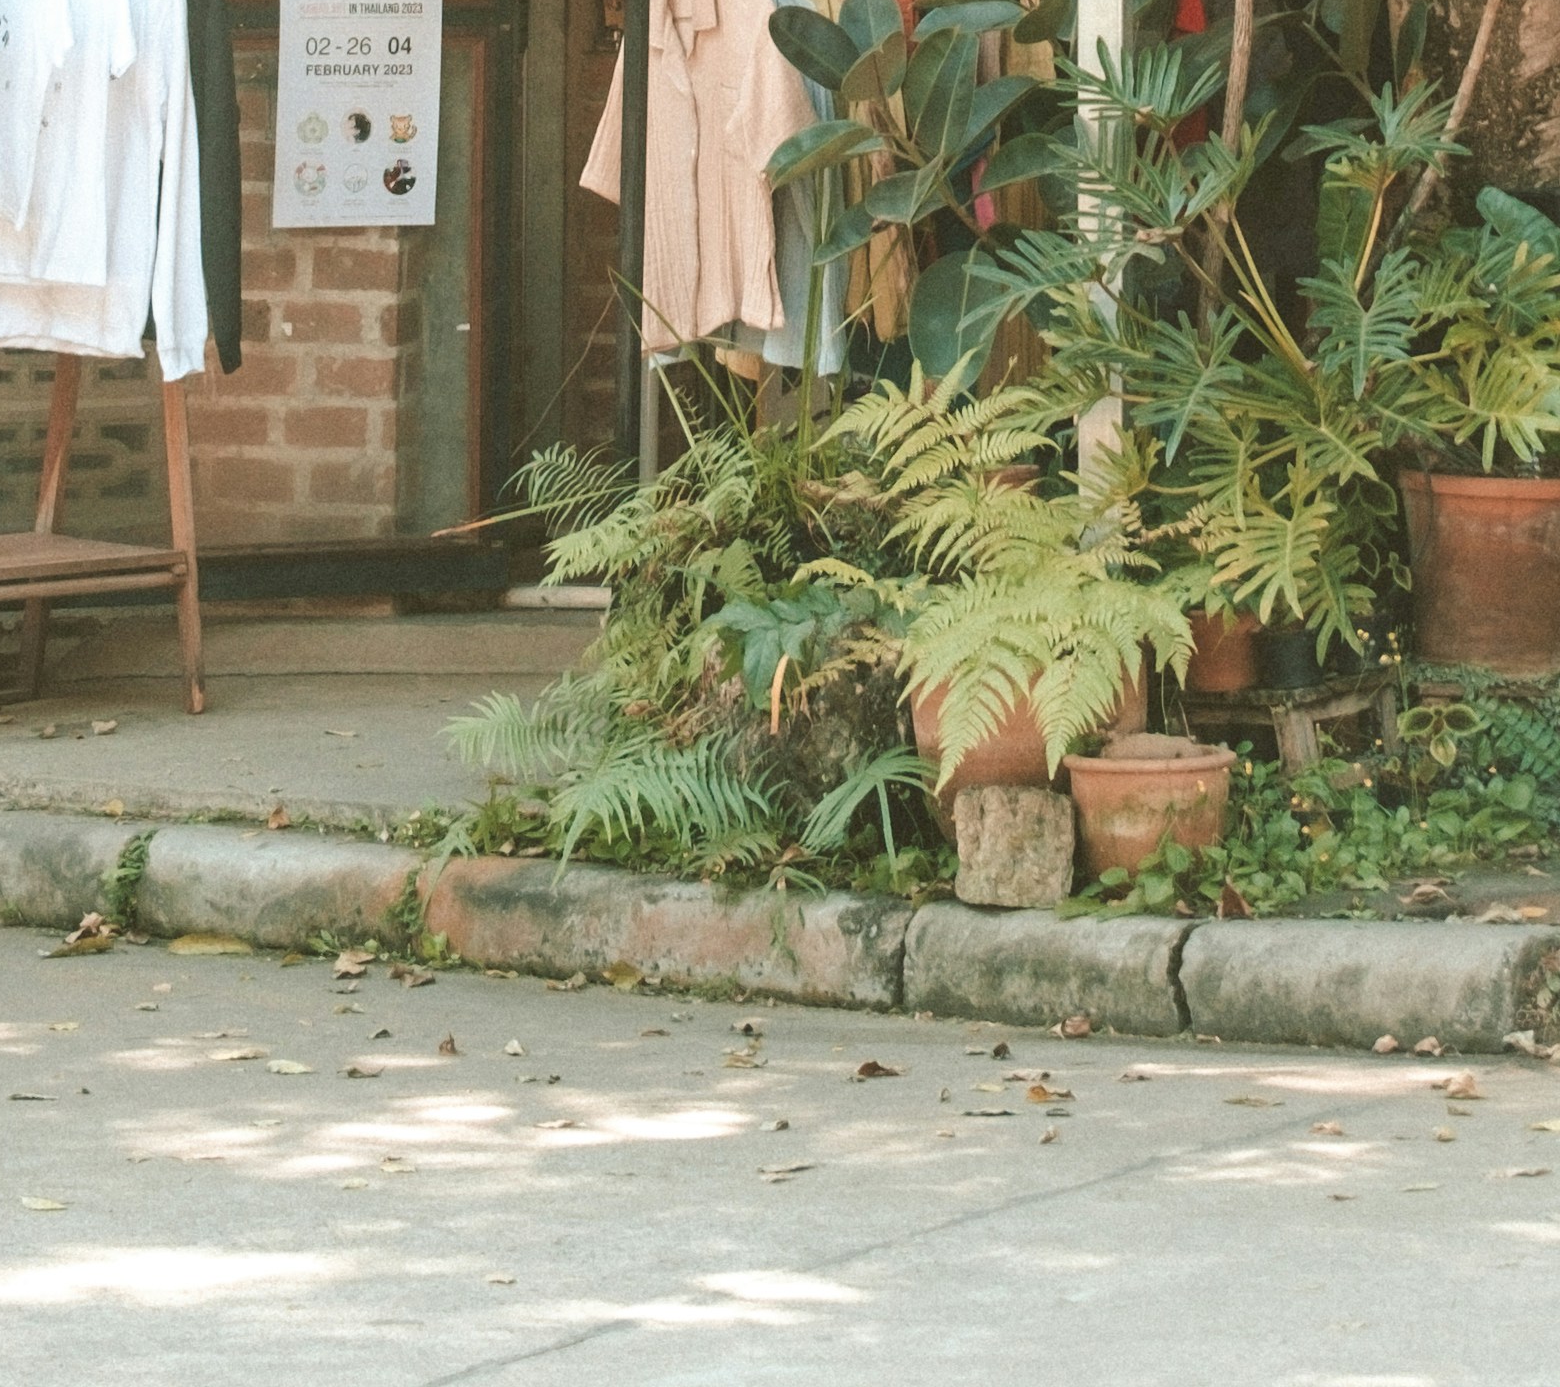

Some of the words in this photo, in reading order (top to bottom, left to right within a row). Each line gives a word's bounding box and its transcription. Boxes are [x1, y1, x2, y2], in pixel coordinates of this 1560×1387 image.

[348, 3, 358, 15] IN
[360, 2, 400, 14] THAILAND
[401, 2, 424, 14] 2023
[388, 36, 412, 55] 04
[306, 64, 380, 76] FEBRUARY
[383, 63, 413, 75] 2023
